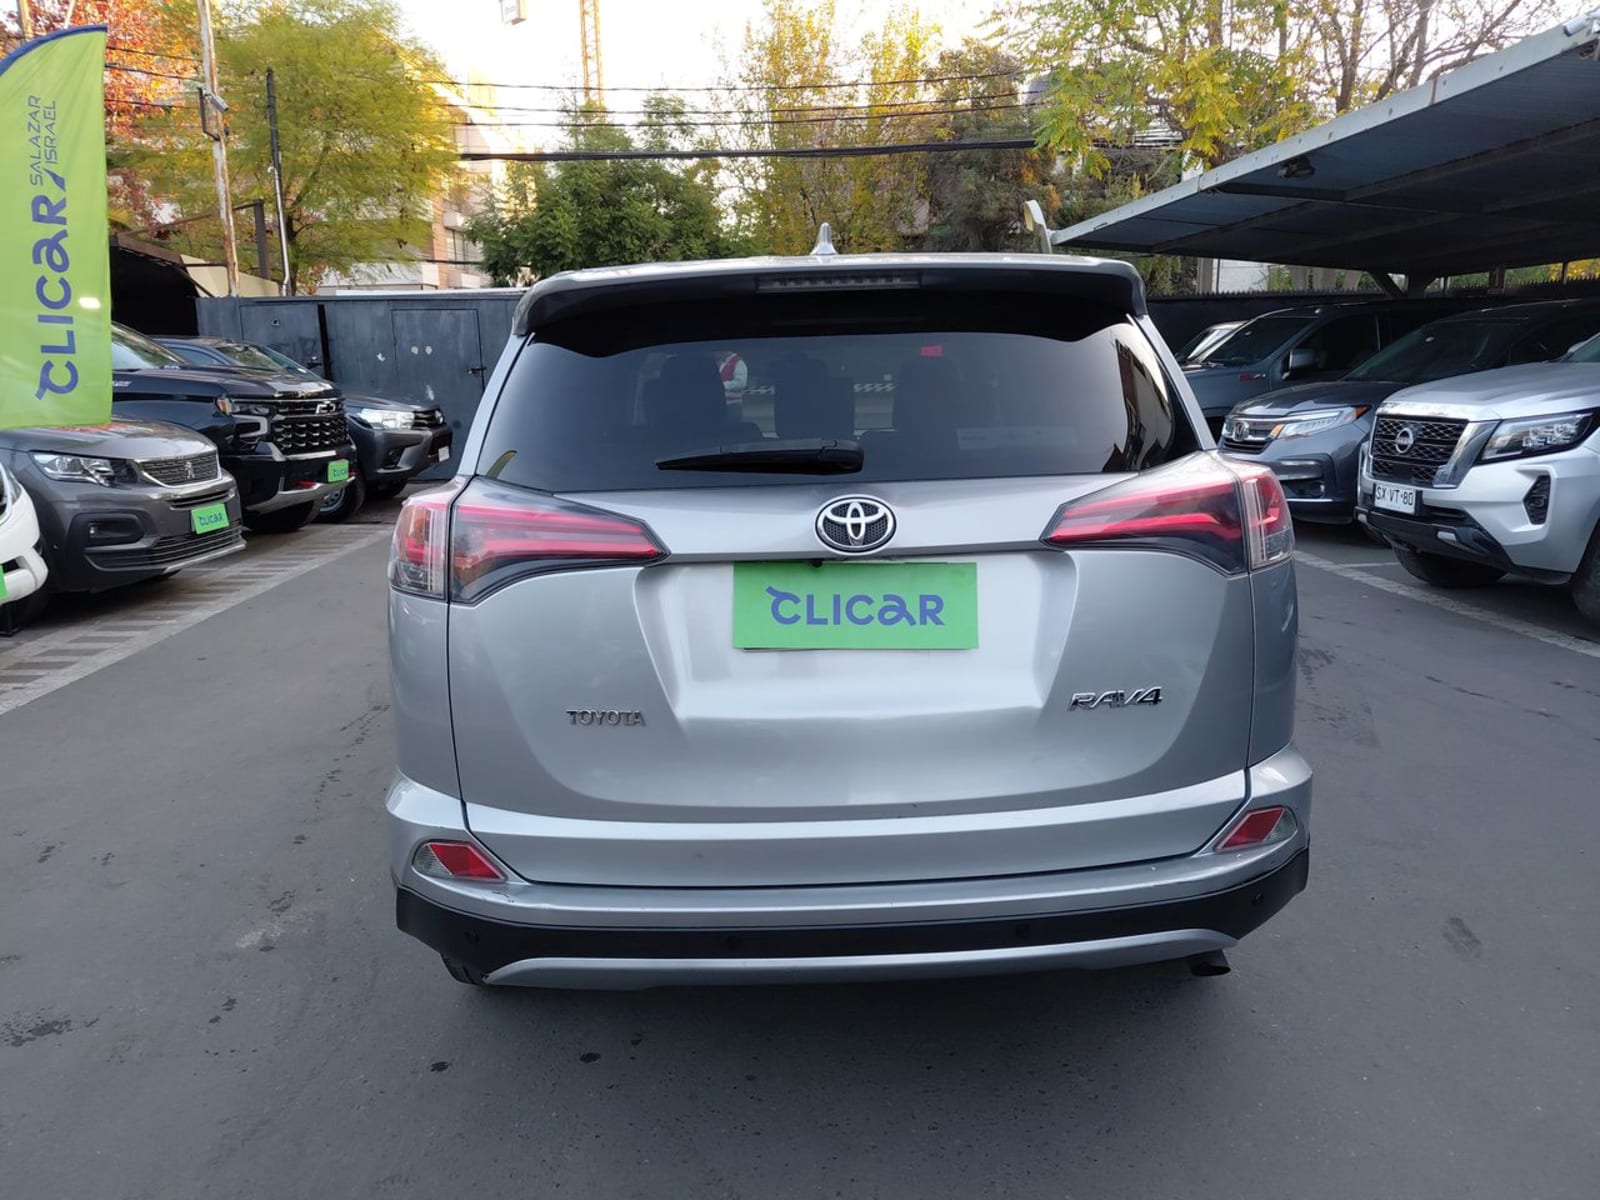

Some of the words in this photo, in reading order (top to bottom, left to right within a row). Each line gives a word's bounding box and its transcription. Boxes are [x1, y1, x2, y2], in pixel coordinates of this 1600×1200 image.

[27, 95, 43, 186] SALAZAR
[43, 101, 57, 164] ISRAEL
[565, 709, 647, 727] TOYOTA
[1067, 686, 1162, 712] RAV4
